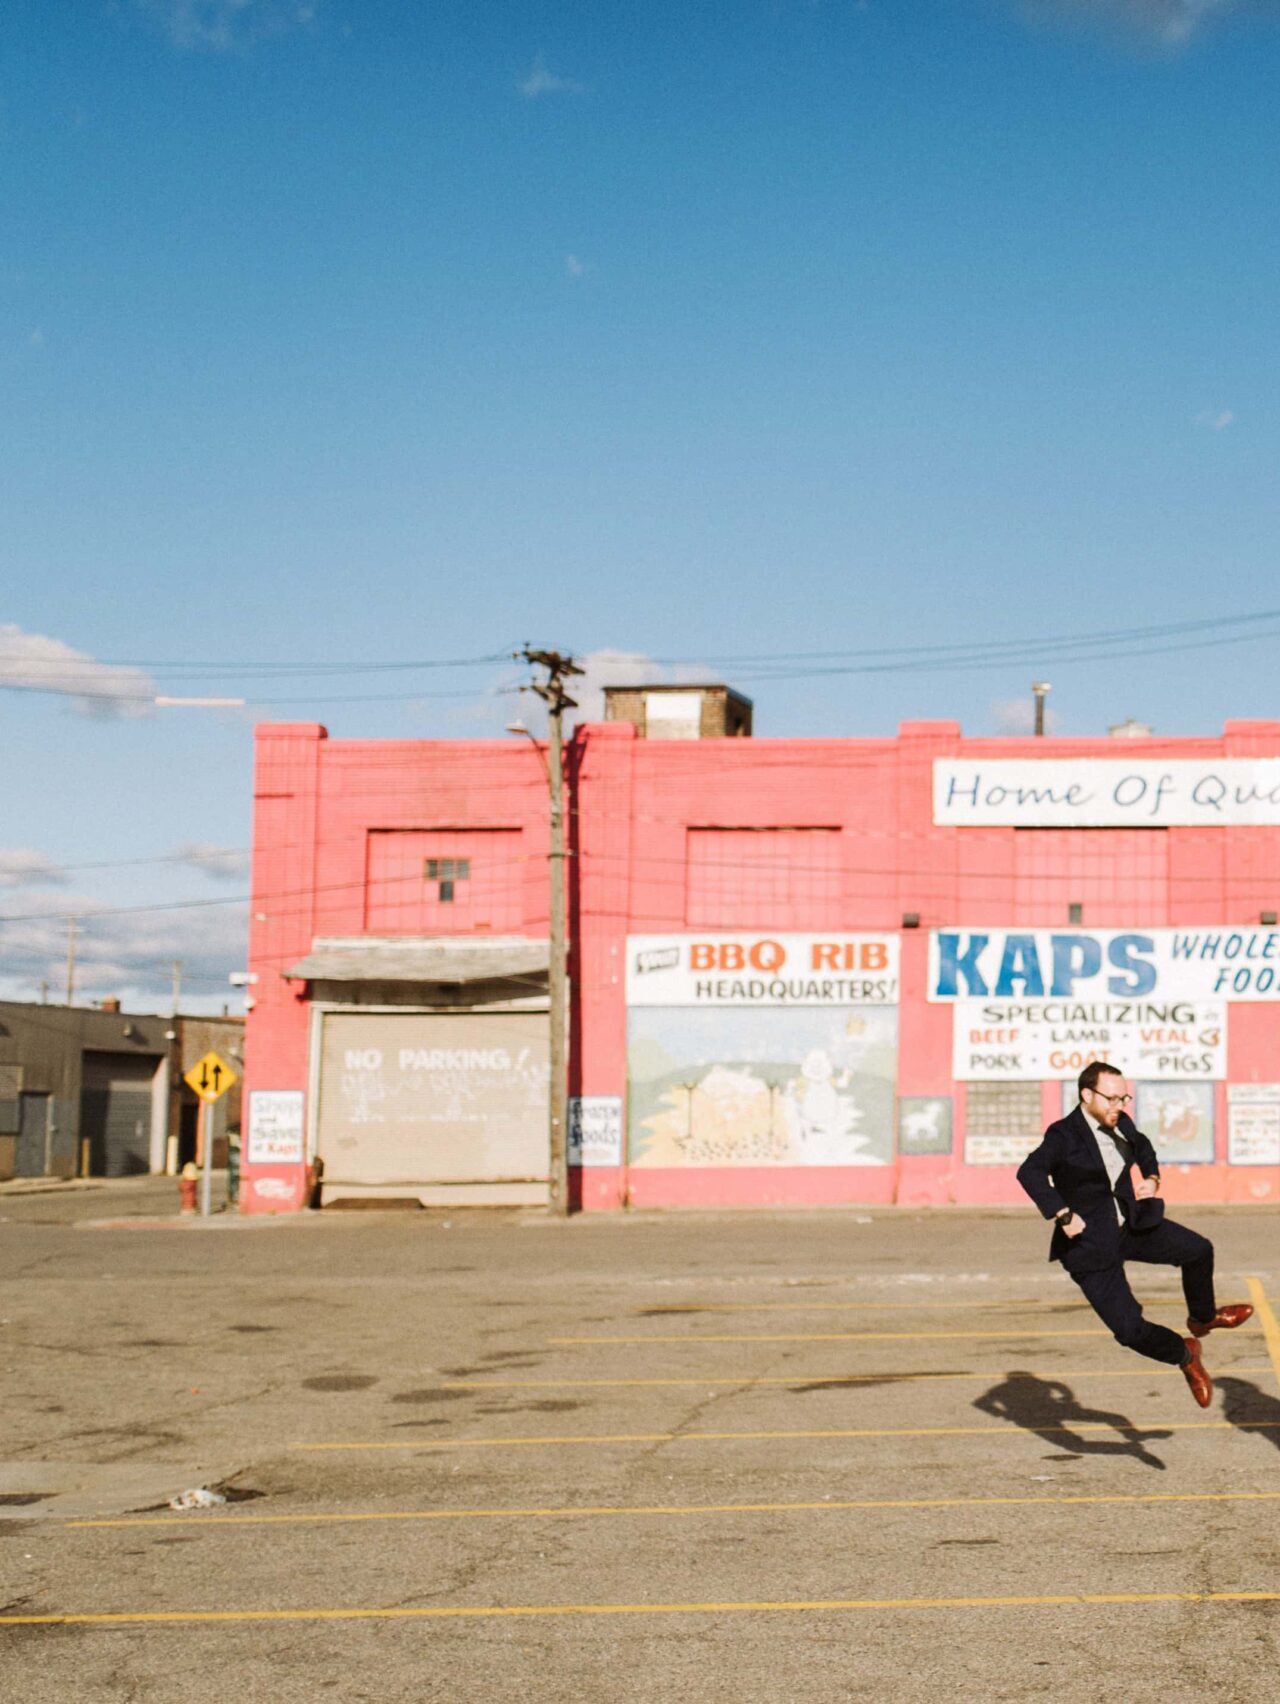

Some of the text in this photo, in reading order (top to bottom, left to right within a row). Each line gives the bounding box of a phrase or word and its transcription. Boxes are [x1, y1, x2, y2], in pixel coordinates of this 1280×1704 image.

[945, 774, 1095, 808] Home
[1113, 774, 1174, 814] Of
[690, 940, 787, 976] BBQ
[811, 942, 889, 971] RIB
[936, 934, 1157, 997] KAPS
[695, 978, 897, 1001] HEADQUARTERS!
[982, 1002, 1196, 1025] SPECIALIZING
[969, 1028, 1020, 1044] BEEF
[1050, 1029, 1111, 1043] LAMB
[1140, 1028, 1191, 1044] VEAL
[344, 1048, 383, 1070] NO
[969, 1050, 1214, 1073] PORK GOAT PIGS
